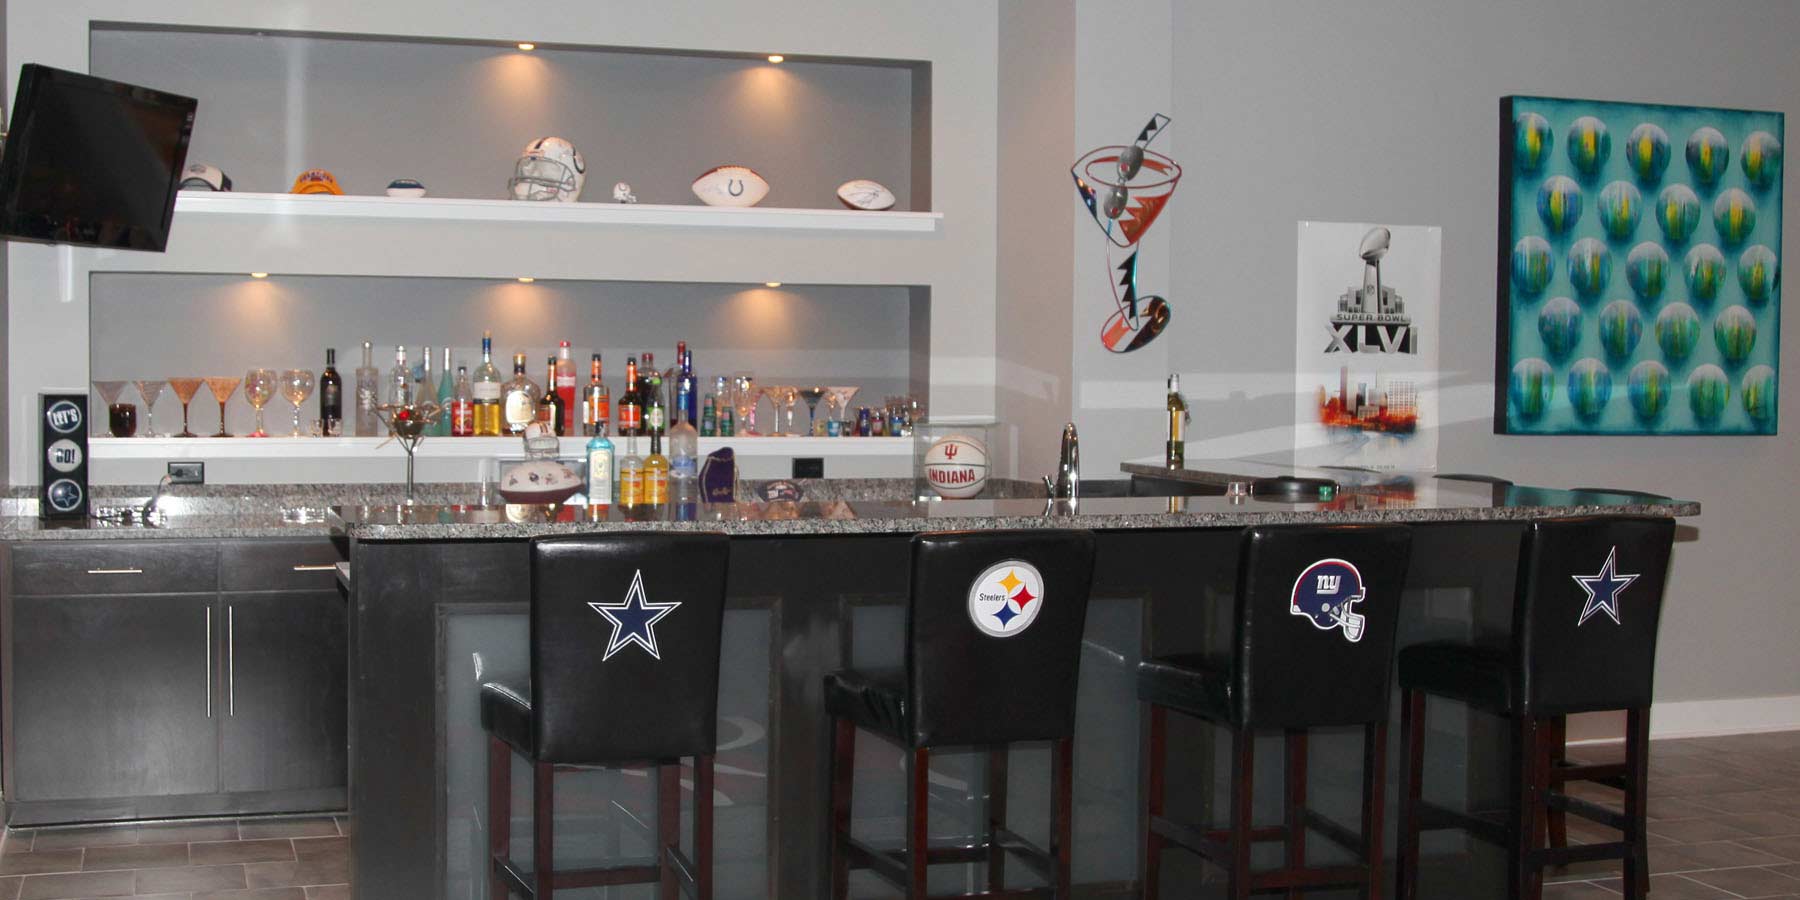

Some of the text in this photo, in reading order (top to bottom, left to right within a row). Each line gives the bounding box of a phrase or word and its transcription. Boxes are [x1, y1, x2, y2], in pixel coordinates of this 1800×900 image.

[1336, 313, 1406, 322] SUPER BOWL
[1324, 323, 1418, 354] XLVI
[52, 408, 78, 426] LET'S
[929, 468, 976, 484] INDIANA
[979, 592, 1006, 602] Steelers
